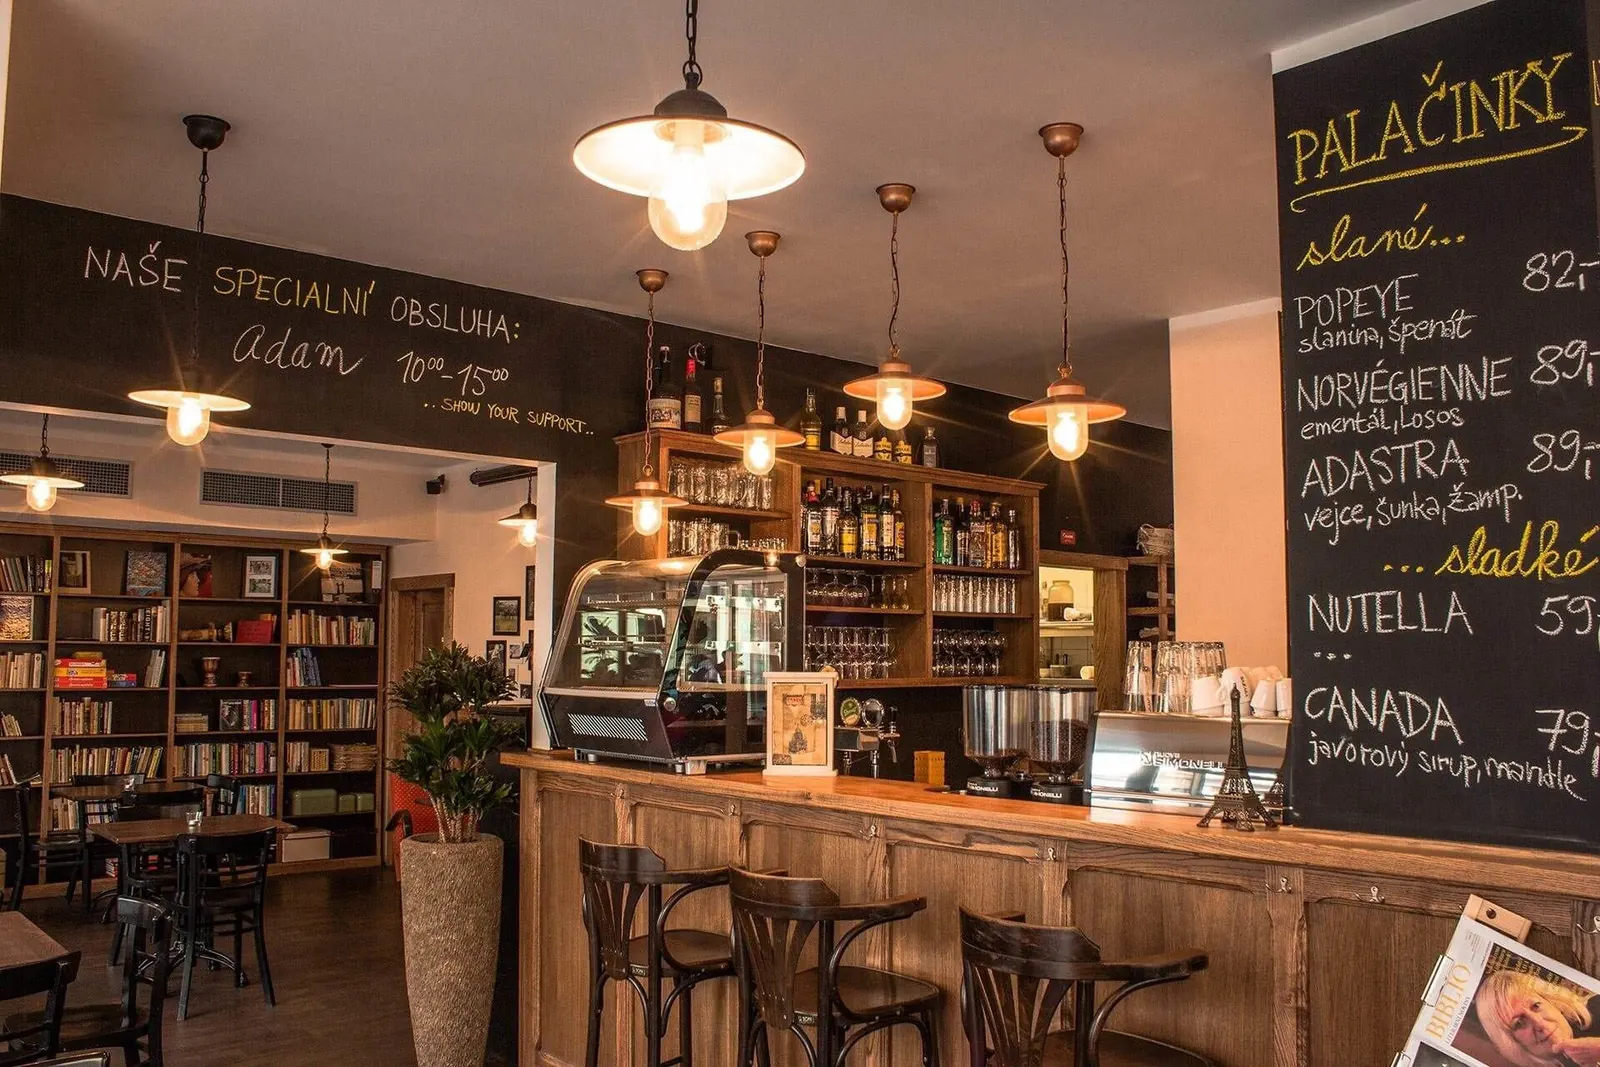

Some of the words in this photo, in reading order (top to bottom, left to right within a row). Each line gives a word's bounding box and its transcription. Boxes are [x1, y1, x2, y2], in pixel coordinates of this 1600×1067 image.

[1287, 53, 1572, 184] PALAČINKY
[83, 241, 188, 293] NAŠE
[213, 266, 376, 316] SPECIALNÍ
[389, 296, 521, 343] OBSLUHA:
[1293, 273, 1419, 328] POPEYE
[1388, 308, 1477, 354] špenát
[487, 403, 519, 424] YOUR
[1297, 356, 1513, 412] NORVÉGIENNE
[1301, 439, 1470, 498] ADASTRA
[1308, 590, 1474, 635] NUTELLA
[1304, 686, 1464, 746] CANADA
[1307, 730, 1409, 777] javorový
[1484, 757, 1588, 802] mandle
[1425, 962, 1471, 1040] BIBLIO
